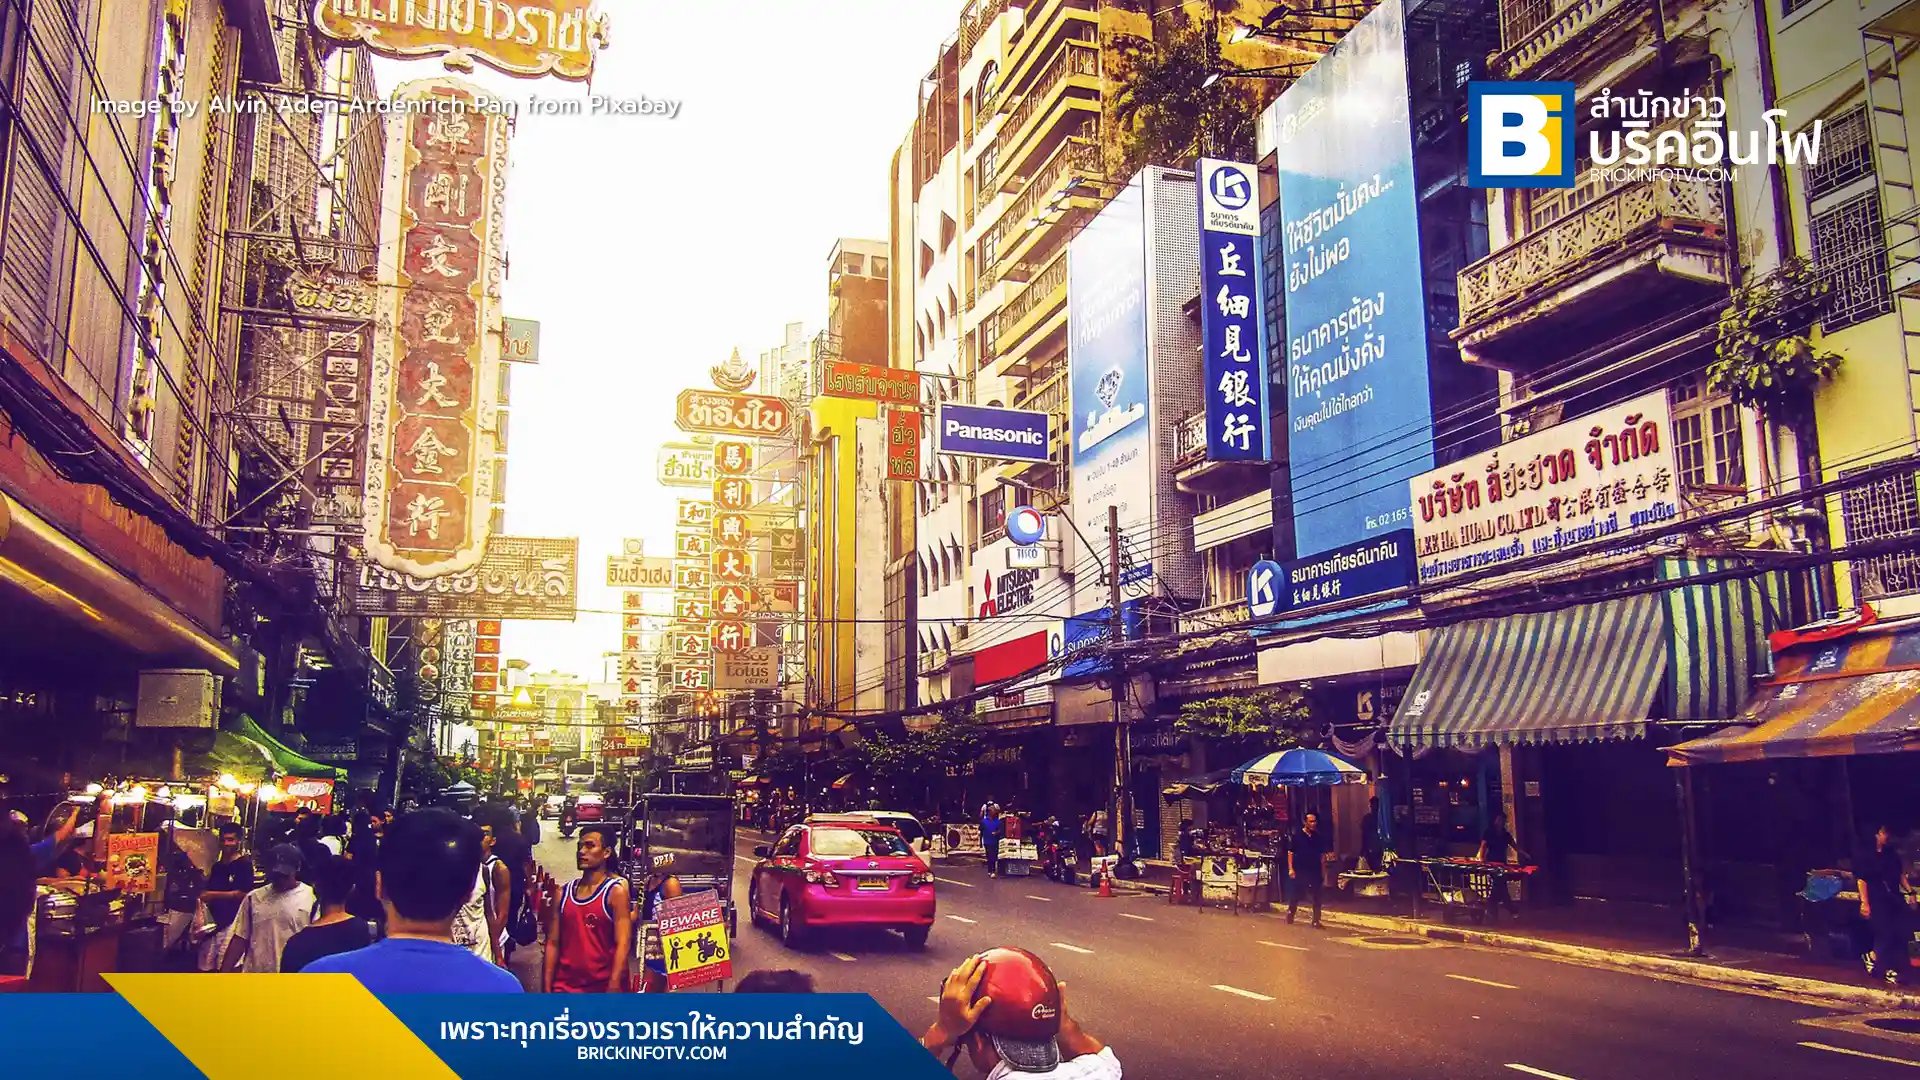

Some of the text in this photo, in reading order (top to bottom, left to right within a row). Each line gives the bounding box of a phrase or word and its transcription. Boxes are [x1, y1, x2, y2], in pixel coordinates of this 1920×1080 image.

[1211, 211, 1239, 221] ธนาคาร
[1290, 237, 1350, 292] ยังไม่พอ
[1292, 292, 1385, 361] ธนาคารต้อง
[1216, 242, 1257, 451] 丘細見銀行
[1292, 324, 1385, 398] ให้คุณมั่งคั่ง
[826, 362, 919, 400] โรงรับจำนำ
[945, 419, 1043, 445] Panasonic
[1418, 471, 1480, 521] บริษัท
[1584, 412, 1660, 471] จำกัด
[1379, 514, 1389, 525] 02
[1392, 511, 1407, 523] 165
[1418, 533, 1440, 558] LEE
[1441, 530, 1459, 552] HA
[1461, 519, 1496, 547] HUAD
[1017, 548, 1038, 559] TISCO
[1292, 541, 1398, 584] ธนาคารเกียรตินาคิน
[997, 584, 1034, 614] ELECTRIC
[725, 650, 769, 661] TESCO
[726, 664, 769, 677] Lotus
[602, 739, 615, 750] 24
[660, 907, 719, 930] BEWARE
[661, 928, 670, 936] OF
